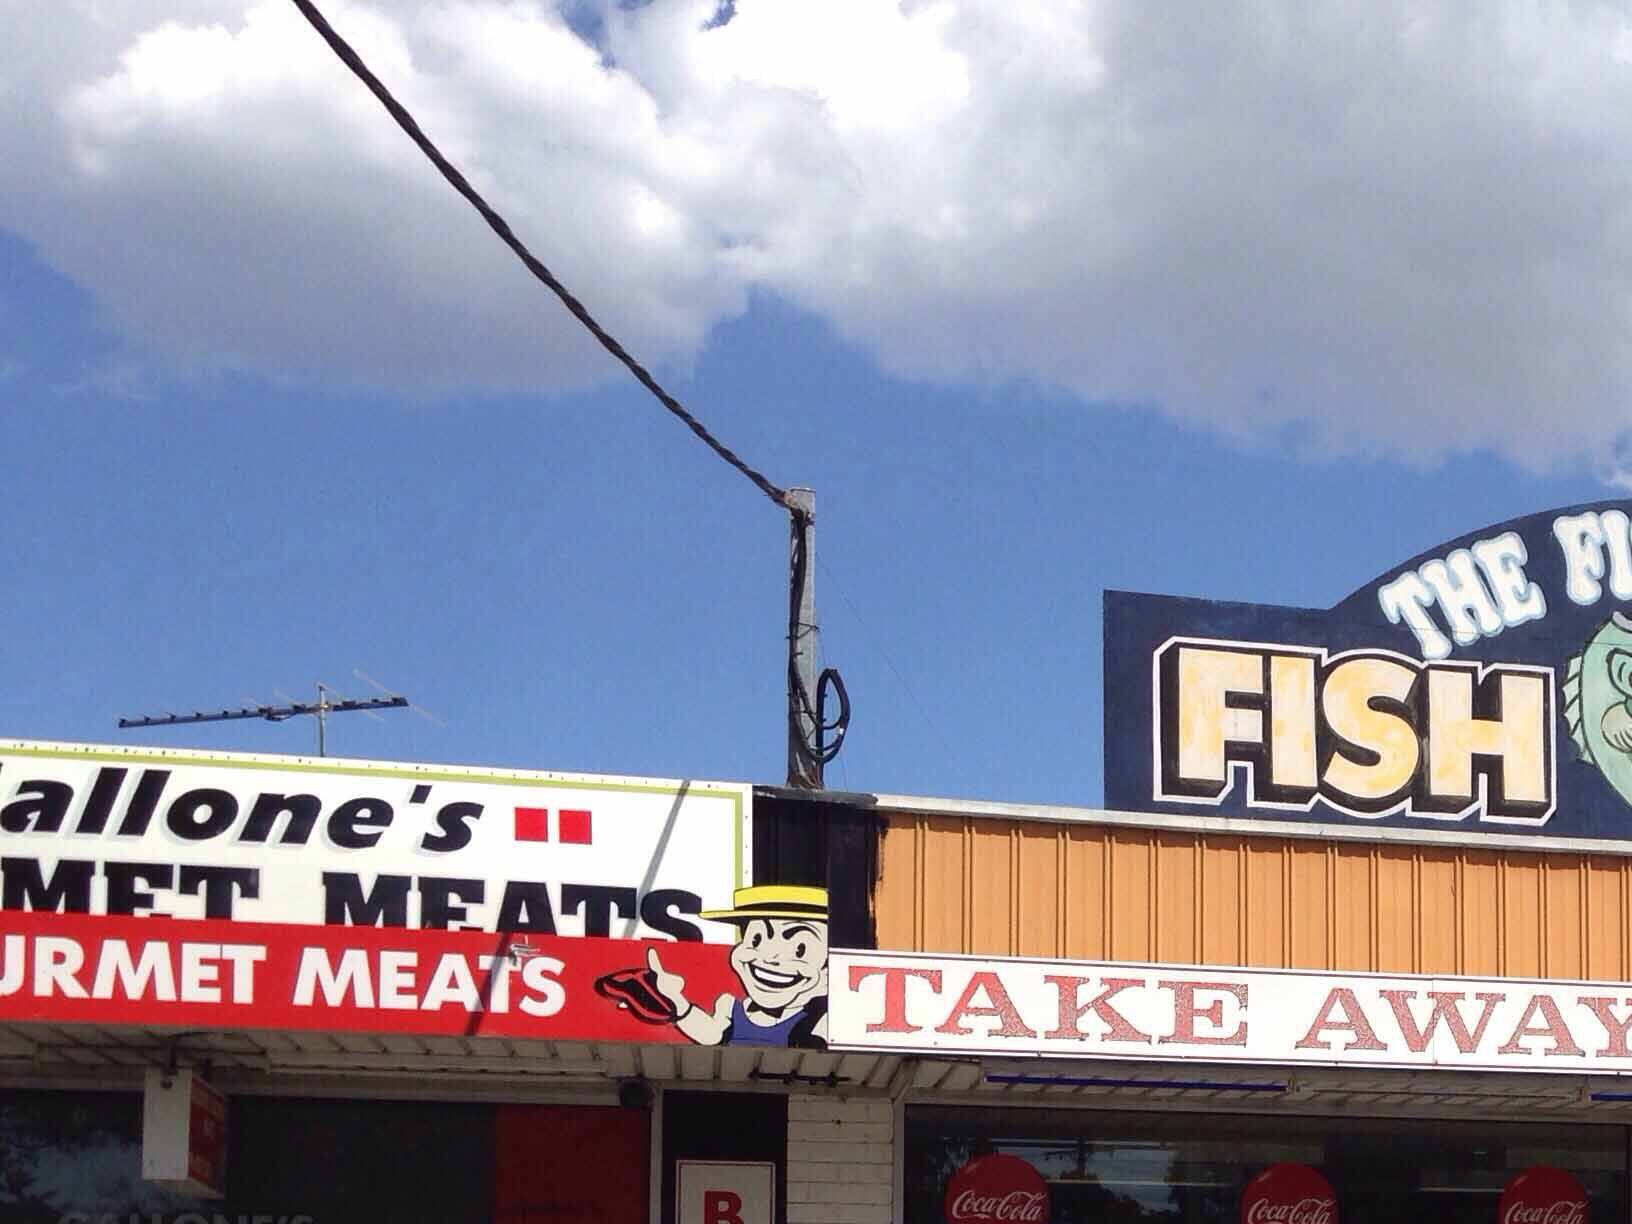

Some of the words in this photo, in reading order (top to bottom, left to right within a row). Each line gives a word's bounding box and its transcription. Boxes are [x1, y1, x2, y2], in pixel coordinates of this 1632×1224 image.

[1378, 532, 1547, 659] THE
[1158, 640, 1553, 820] FISH
[0, 766, 485, 852] allone's
[322, 871, 705, 943] MEATS
[292, 947, 567, 1017] MEATS
[848, 965, 1249, 1047] TAKE
